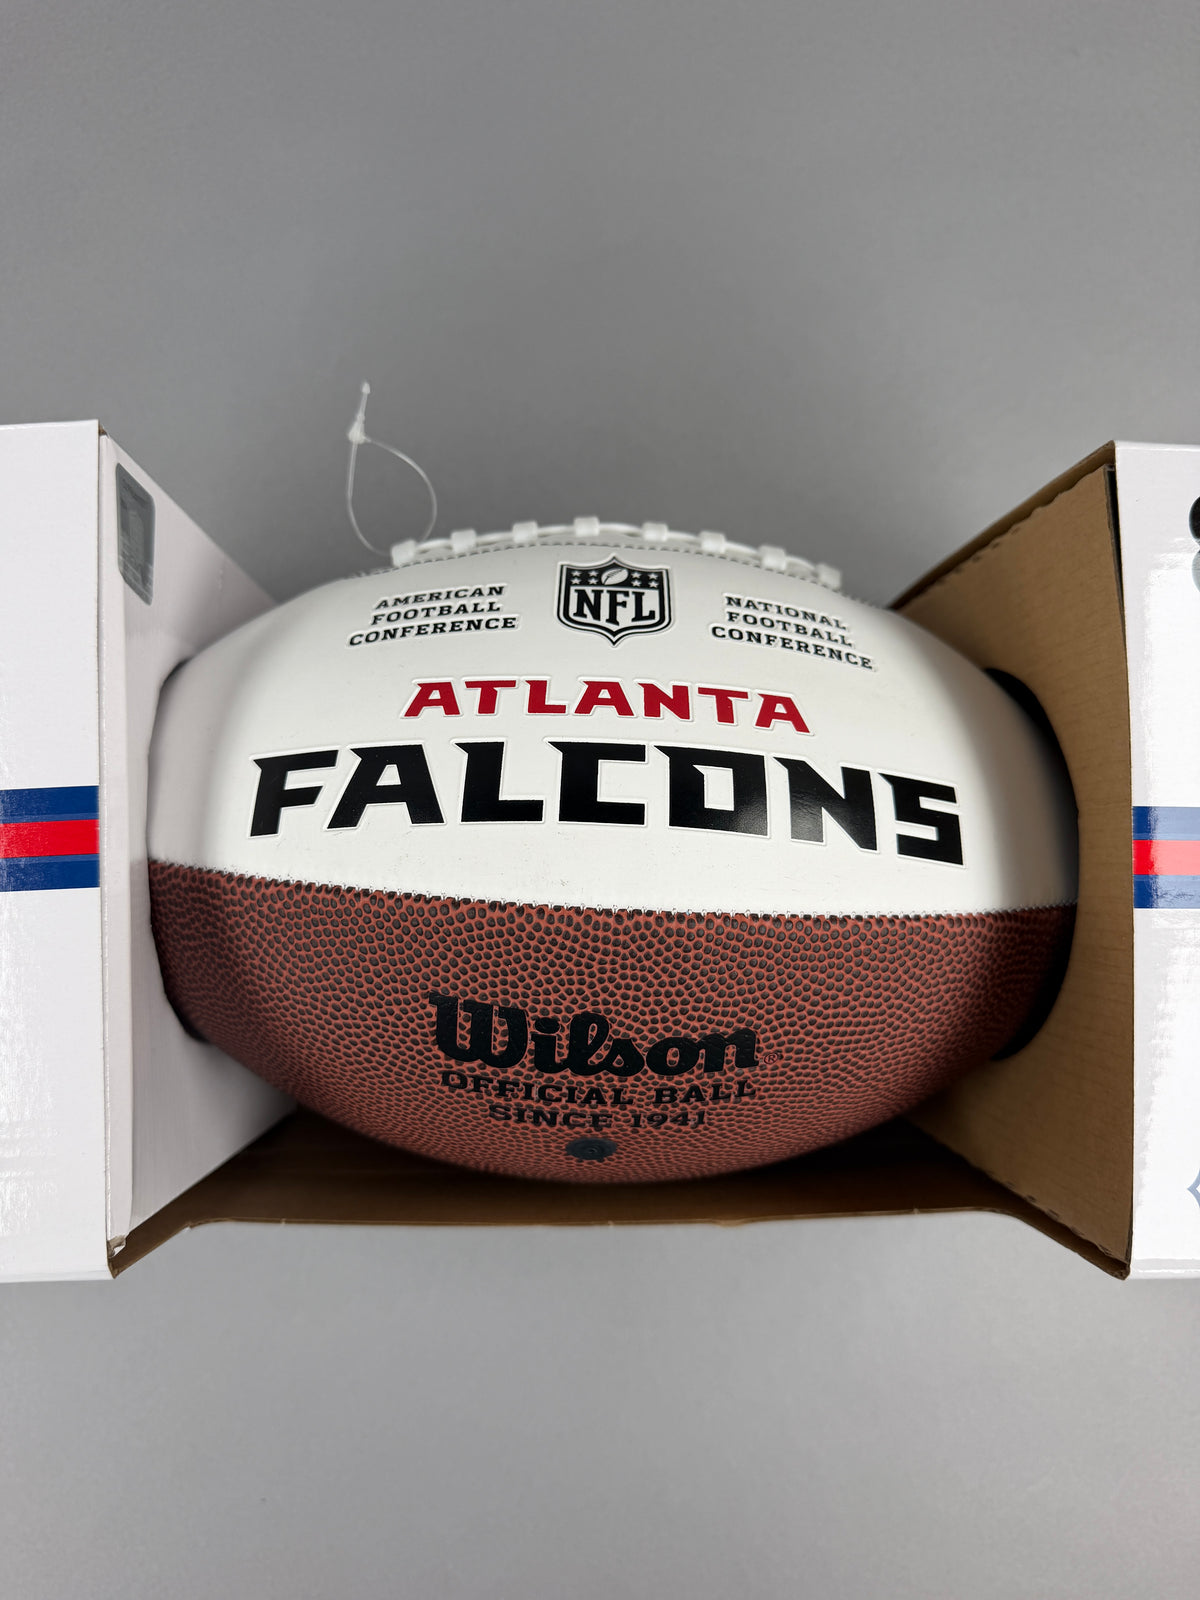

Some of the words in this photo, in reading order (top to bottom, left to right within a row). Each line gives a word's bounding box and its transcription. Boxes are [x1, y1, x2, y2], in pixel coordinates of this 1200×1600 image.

[370, 600, 502, 625] FOOTBALL
[376, 584, 505, 609] AMERICAN
[573, 588, 657, 626] NFL
[725, 595, 848, 630] NATIONAL
[348, 616, 517, 646] CONFERENCE
[726, 611, 853, 647] FOOTBALL
[711, 625, 874, 670] CONFERENCE
[403, 679, 814, 735] ATLANTA
[250, 740, 965, 866] FALCONS
[428, 993, 759, 1077] Wilson
[441, 1070, 635, 1105] OFFICIAL
[653, 1079, 757, 1104] BALL
[488, 1104, 613, 1128] SINCE
[630, 1109, 708, 1128] 1941
